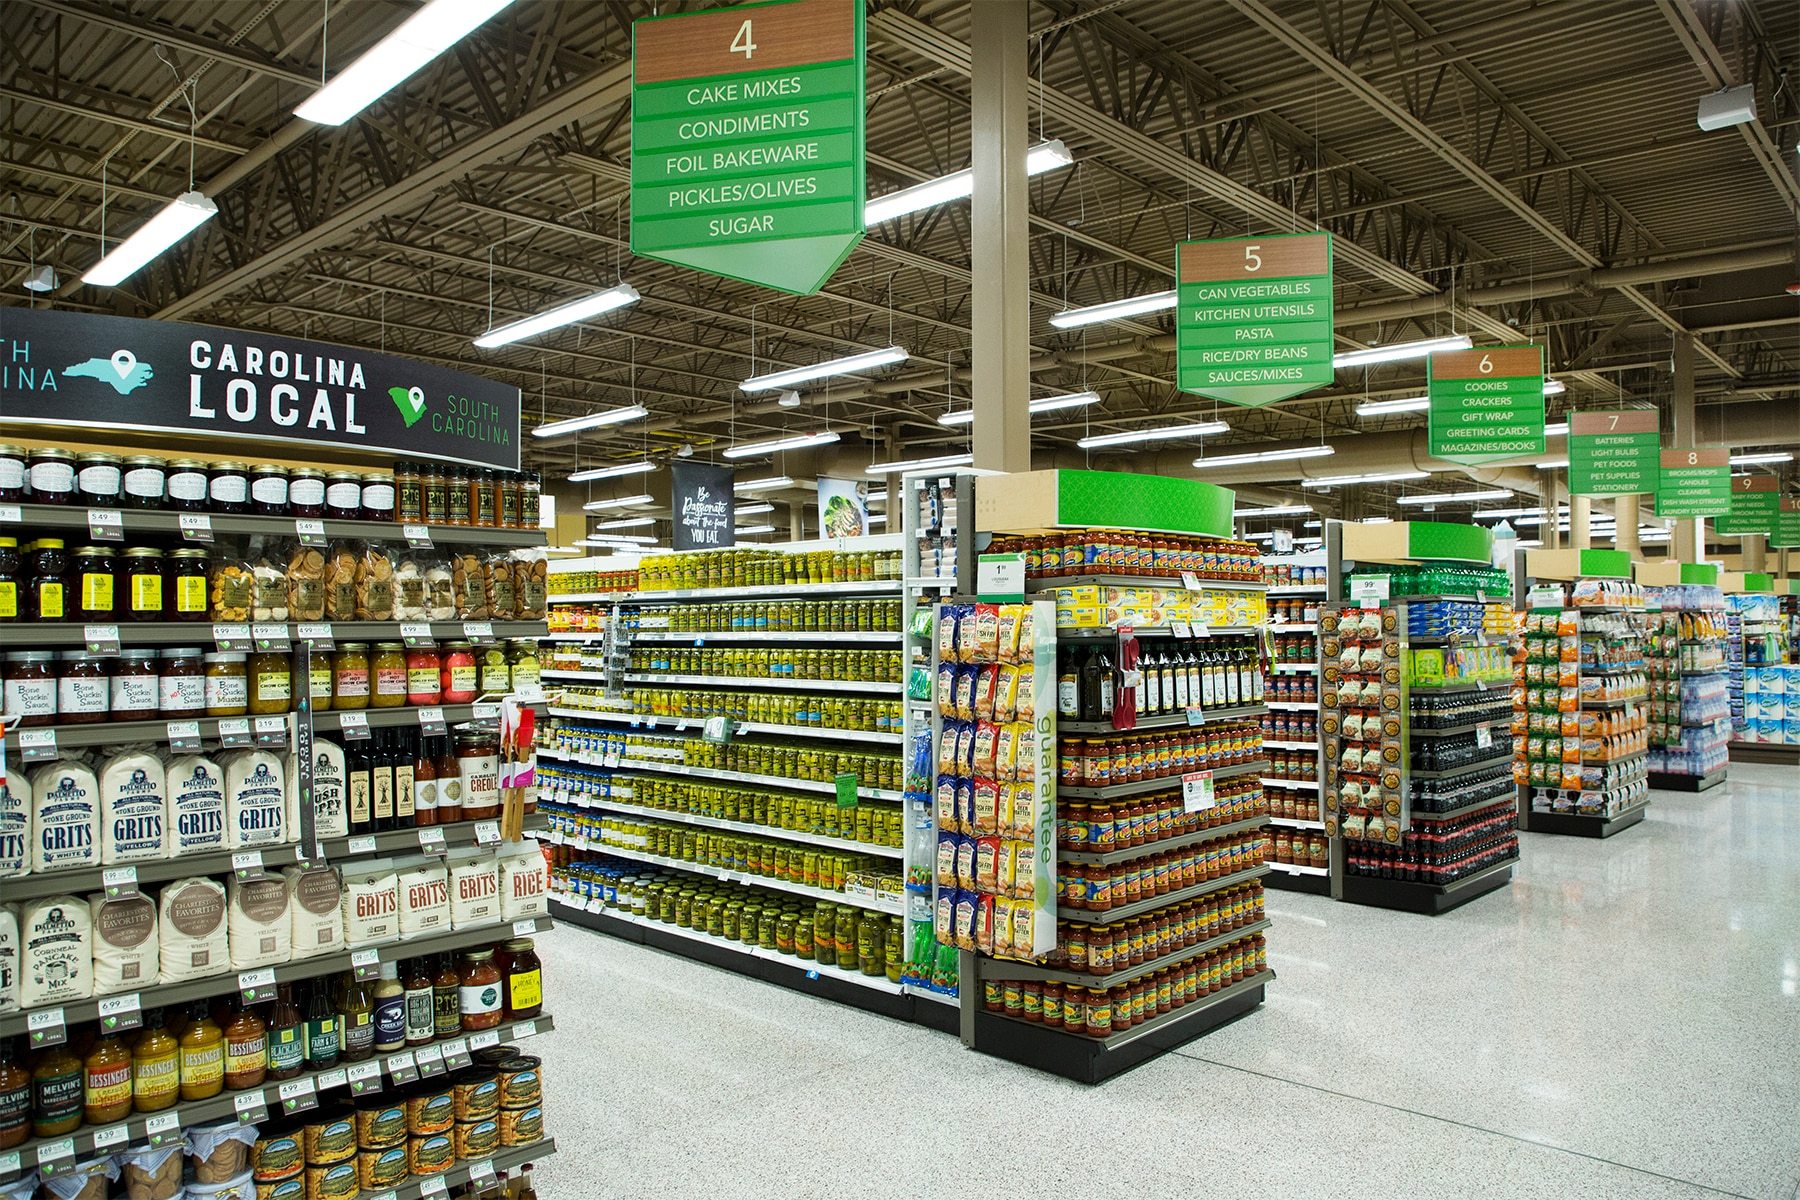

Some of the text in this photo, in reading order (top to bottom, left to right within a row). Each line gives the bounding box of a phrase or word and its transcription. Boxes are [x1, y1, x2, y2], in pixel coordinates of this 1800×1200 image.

[730, 19, 757, 59] 4
[687, 77, 801, 105] CAKE MIXES
[679, 110, 810, 139] CONDIMENTS
[666, 143, 819, 174] FOIL BAKEWARE
[669, 177, 817, 207] PICKLES/OLIVES
[709, 215, 774, 236] SUGAR
[1244, 245, 1262, 272] 5
[1199, 283, 1311, 300] CAN VEGETABLES
[1194, 304, 1315, 321] KITCHEN UTENSILS
[1235, 328, 1274, 340] PASTA
[1202, 347, 1308, 363] RICE/DRY BEANS
[1479, 354, 1493, 373] 6
[190, 340, 366, 390] CAROLINA
[1208, 368, 1303, 383] SAUCES/MIXES
[1464, 382, 1508, 392] COOKIES
[189, 374, 366, 434] LOCAL
[448, 395, 500, 423] SOUTH
[1462, 397, 1512, 406] CRACKERS
[1462, 412, 1514, 421] GIFT WRAP
[1608, 416, 1619, 430] 7
[432, 413, 510, 446] CAROLINA
[1447, 427, 1530, 437] GREETING CARDS
[1441, 442, 1536, 452] MAGAZINES/BOOKS
[1688, 452, 1698, 465] 8
[1744, 478, 1752, 490] 9
[697, 486, 710, 502] Be
[682, 516, 728, 530] about the food
[691, 528, 704, 543] YOU
[18, 686, 40, 694] Bone
[74, 683, 94, 692] Bone
[123, 682, 144, 690] Bone
[177, 682, 196, 690] Bone
[1037, 716, 1054, 864] guarantee
[178, 810, 222, 836] GRITS
[240, 806, 280, 830] GRITS
[42, 823, 92, 850] GRITS
[114, 815, 162, 841] GRITS
[304, 884, 337, 894] FAVORITES
[460, 874, 496, 900] GRITS
[513, 872, 544, 898] RICE
[175, 898, 219, 910] CHARLESTON
[248, 891, 283, 902] FAVORITES
[409, 882, 447, 909] GRITS
[176, 904, 220, 918] FAVORITES
[357, 891, 396, 918] GRITS
[102, 907, 148, 920] CHARLESTON
[103, 914, 150, 929] FAVORITES
[33, 954, 80, 971] PANCAKE
[89, 1066, 132, 1088] BESSINGER'S
[43, 1078, 80, 1096] MELVIN'S
